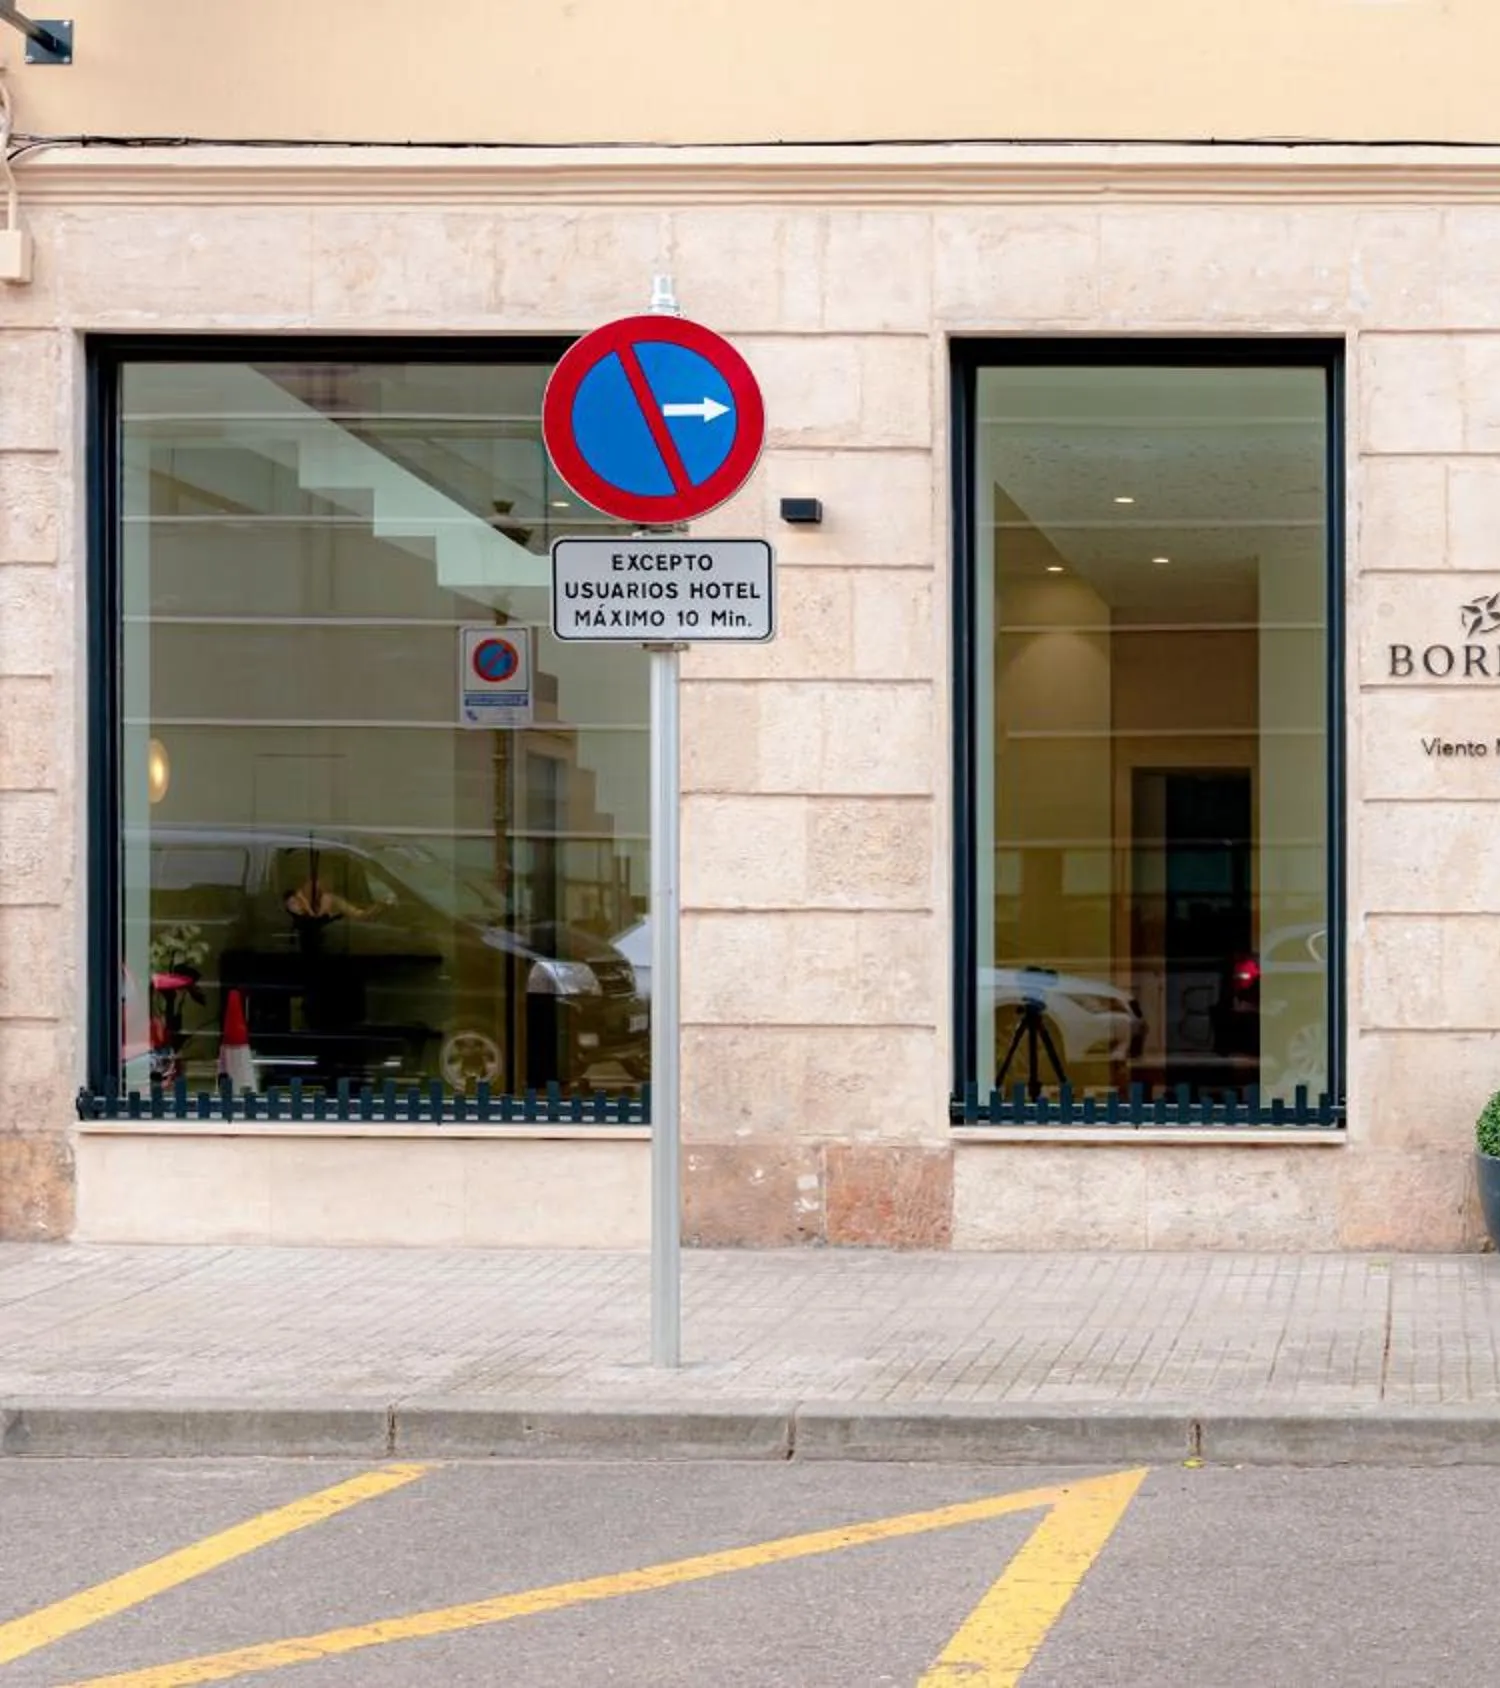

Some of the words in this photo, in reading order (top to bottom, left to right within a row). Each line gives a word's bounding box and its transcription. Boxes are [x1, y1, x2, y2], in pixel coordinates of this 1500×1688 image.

[611, 553, 714, 572] EXCEPTO
[564, 581, 679, 600] USUARIOS
[689, 581, 761, 600] HOTEL
[574, 603, 665, 627] MÁXIMO
[677, 609, 699, 627] 10
[710, 609, 753, 627] Min.
[1420, 737, 1488, 758] Viento
